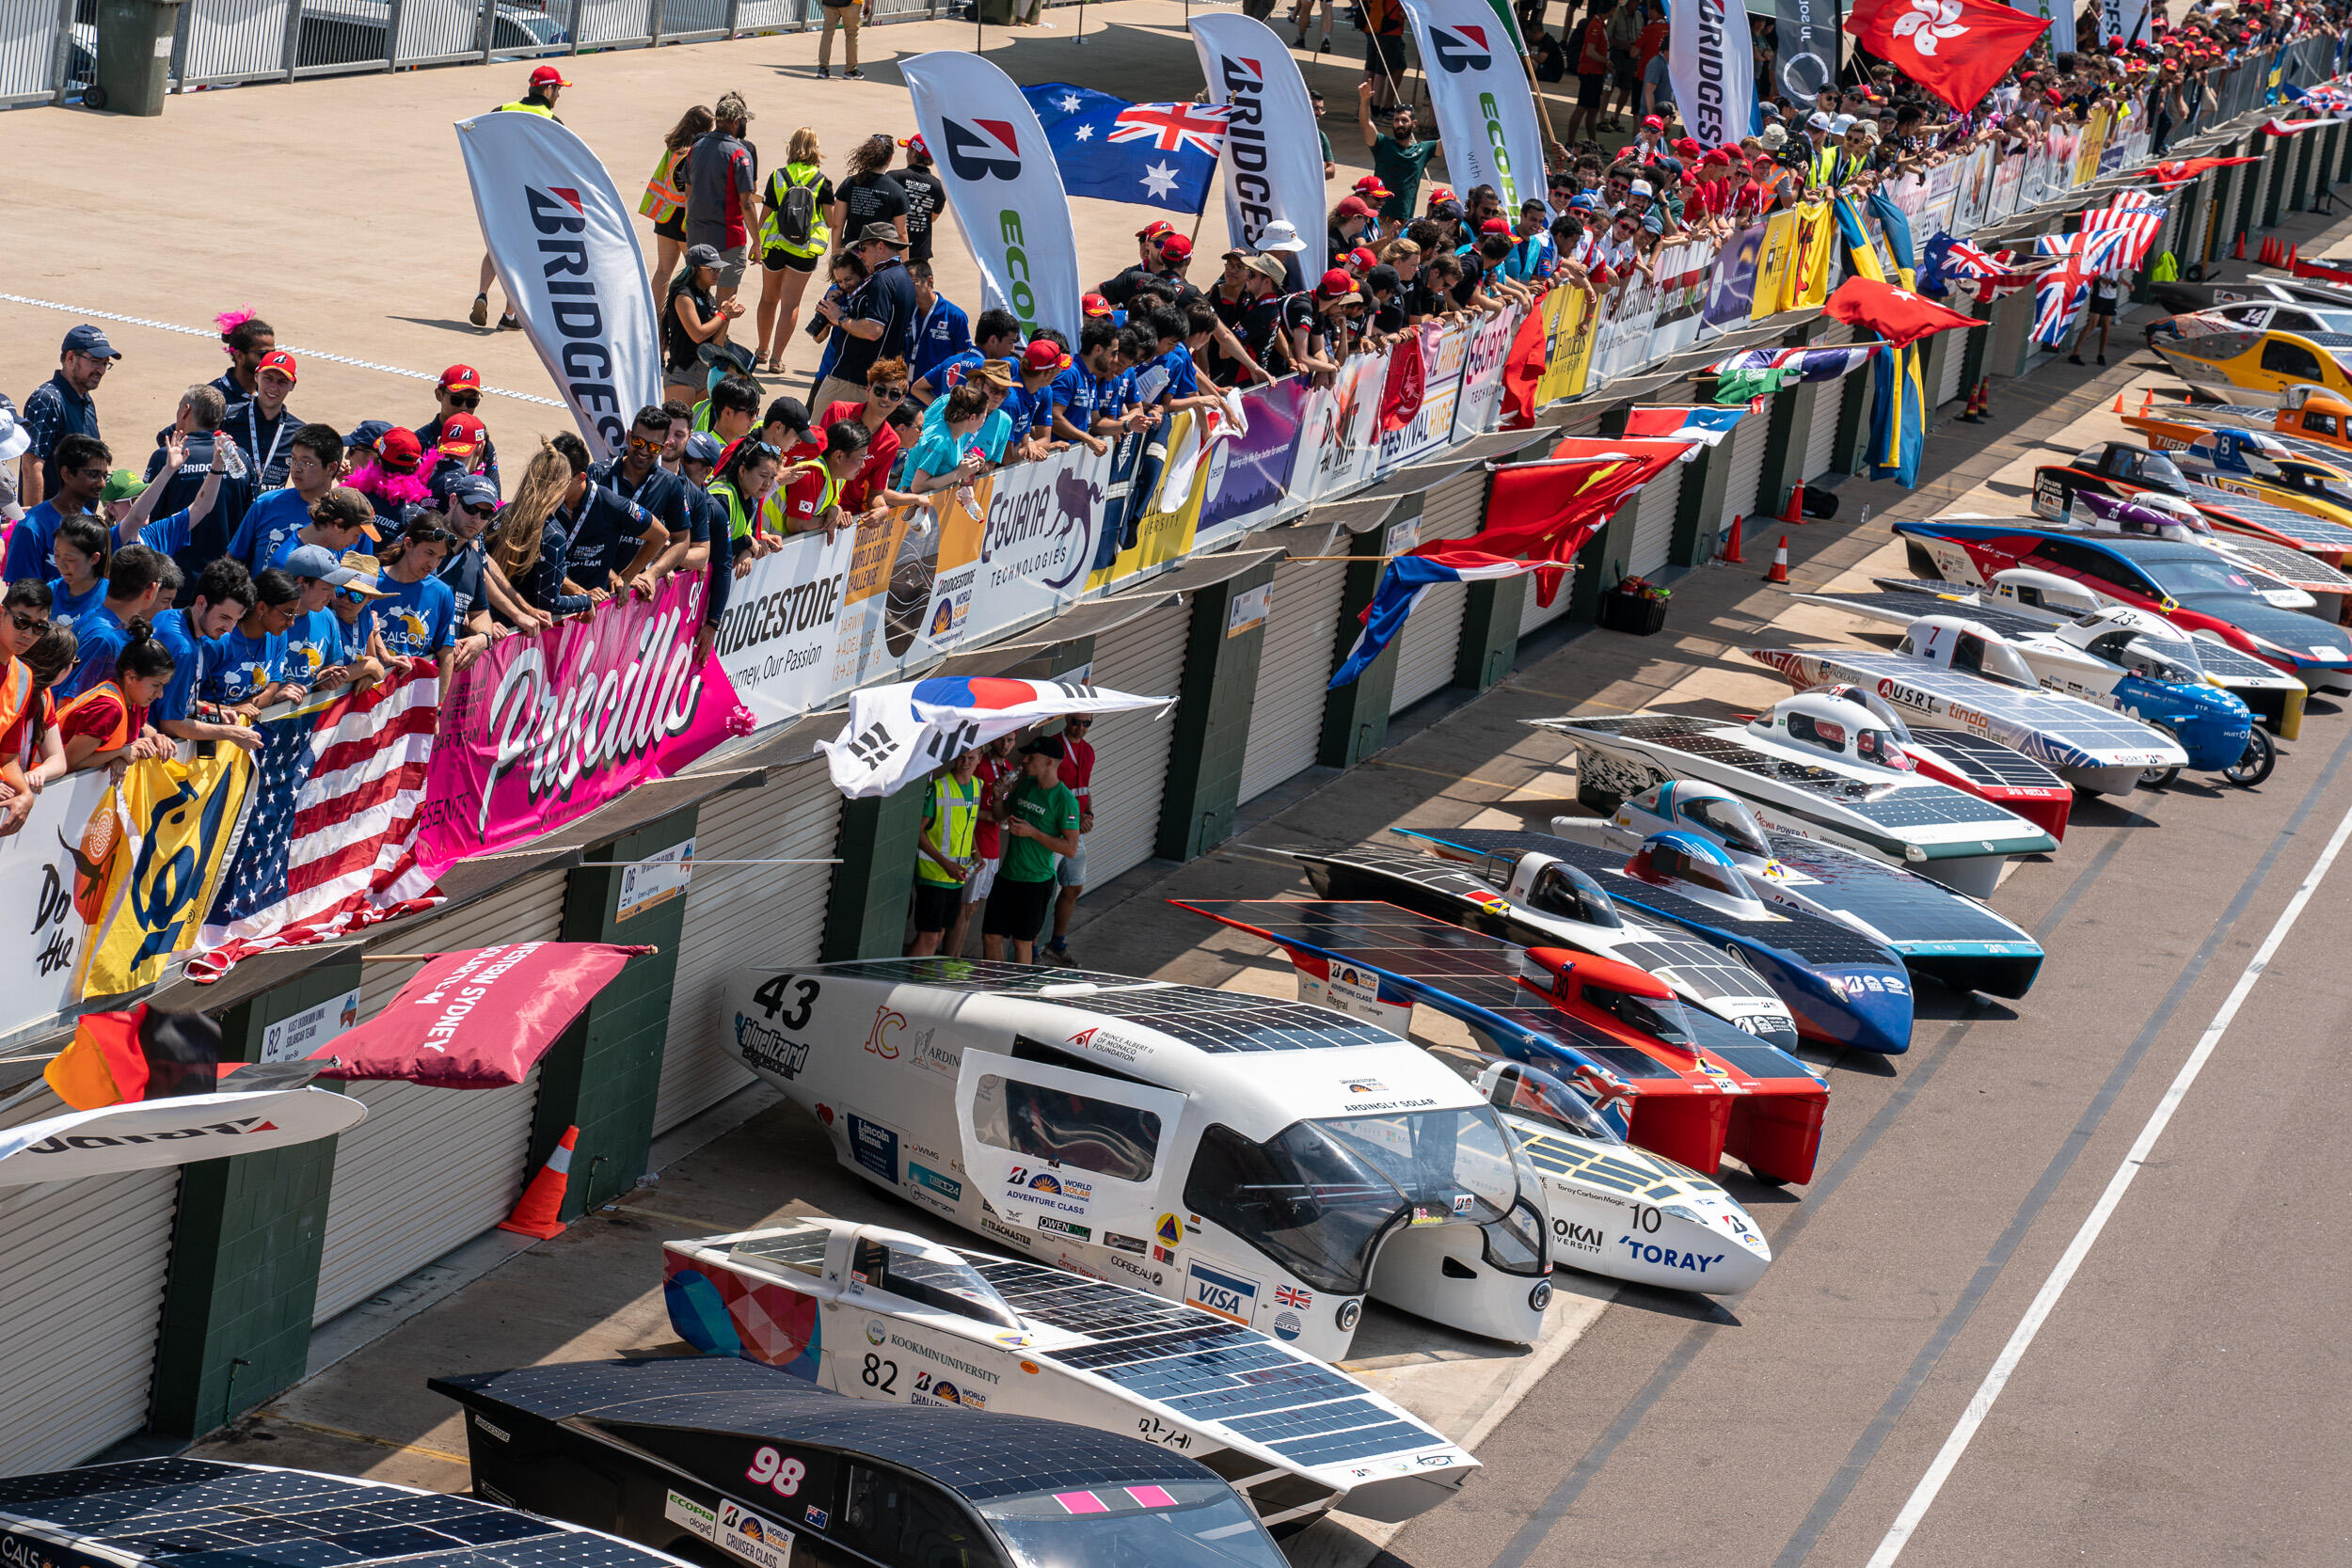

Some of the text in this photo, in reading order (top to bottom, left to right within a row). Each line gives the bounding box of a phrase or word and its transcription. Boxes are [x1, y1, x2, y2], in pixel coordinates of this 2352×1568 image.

[1468, 150, 1481, 179] with
[1438, 336, 1467, 375] HIRE
[1428, 398, 1454, 437] HIRE
[2156, 435, 2191, 451] TIGRI
[2221, 436, 2230, 454] 8
[1139, 513, 1181, 536] IVERSITY
[2107, 508, 2120, 519] 20
[851, 541, 891, 571] WORLD SOLAR
[991, 546, 1067, 588] TECHNOLOGIES
[847, 566, 880, 595] CHALLENGE
[686, 581, 705, 626] 98
[956, 589, 972, 607] WORLD
[714, 572, 843, 657] RIDGESTONE
[953, 602, 970, 620] SOLAR
[2110, 610, 2135, 626] 23
[839, 612, 866, 635] DARWIN
[1929, 626, 1941, 645] 7
[764, 654, 783, 680] Our
[785, 641, 822, 674] Passion
[478, 607, 703, 844] Priscilla
[1949, 703, 1988, 728] tindo
[419, 791, 470, 832] ESENTS
[1776, 825, 1800, 836] POWER
[625, 867, 636, 894] 06
[30, 863, 72, 935] Do
[36, 927, 73, 977] the
[423, 941, 548, 1053] WESTERN SYDNEY
[1356, 991, 1372, 1003] CLASS
[1554, 972, 1569, 1002] 30
[753, 974, 820, 1031] 43
[1327, 994, 1348, 1011] integral
[267, 1026, 281, 1057] 82
[1092, 1043, 1136, 1063] FOUNDATION
[1101, 1031, 1123, 1043] PRINCE
[1124, 1038, 1148, 1052] ALBERT
[1107, 1040, 1136, 1055] MONACO
[929, 1047, 961, 1067] ARDIN
[1344, 1099, 1437, 1112] ARDINGLY SOLAR
[858, 1119, 889, 1143] Lincoln
[859, 1131, 882, 1149] Binns.
[918, 1146, 939, 1160] WMG
[1062, 1192, 1089, 1202] CHALLENGE
[1063, 1185, 1091, 1197] SOLAR
[1064, 1179, 1092, 1191] WORLD
[1557, 1182, 1626, 1208] Toray Carbon Magic
[1007, 1190, 1085, 1215] ADVENTURE CLASS
[1629, 1203, 1661, 1234] 10
[988, 1219, 1032, 1246] TRACMASTER
[1552, 1235, 1601, 1255] IVERSITY
[1057, 1259, 1077, 1273] cirrus
[1111, 1255, 1152, 1280] CORBEAU
[1198, 1281, 1241, 1316] VISA
[1274, 1320, 1302, 1335] ANTALA
[891, 1333, 1001, 1385] KOOKMIN UNIVERSITY
[862, 1353, 898, 1396] 82
[961, 1395, 985, 1409] SOLAR
[962, 1387, 986, 1402] WORLD
[475, 1415, 511, 1443] BRIDGESTONE
[1138, 1418, 1192, 1449] 만세
[745, 1446, 806, 1497] 98
[765, 1533, 787, 1550] SOLAR
[767, 1525, 788, 1542] WORLD
[725, 1532, 778, 1568] CRUISER CLASS
[764, 1541, 786, 1555] CHALLENGE
